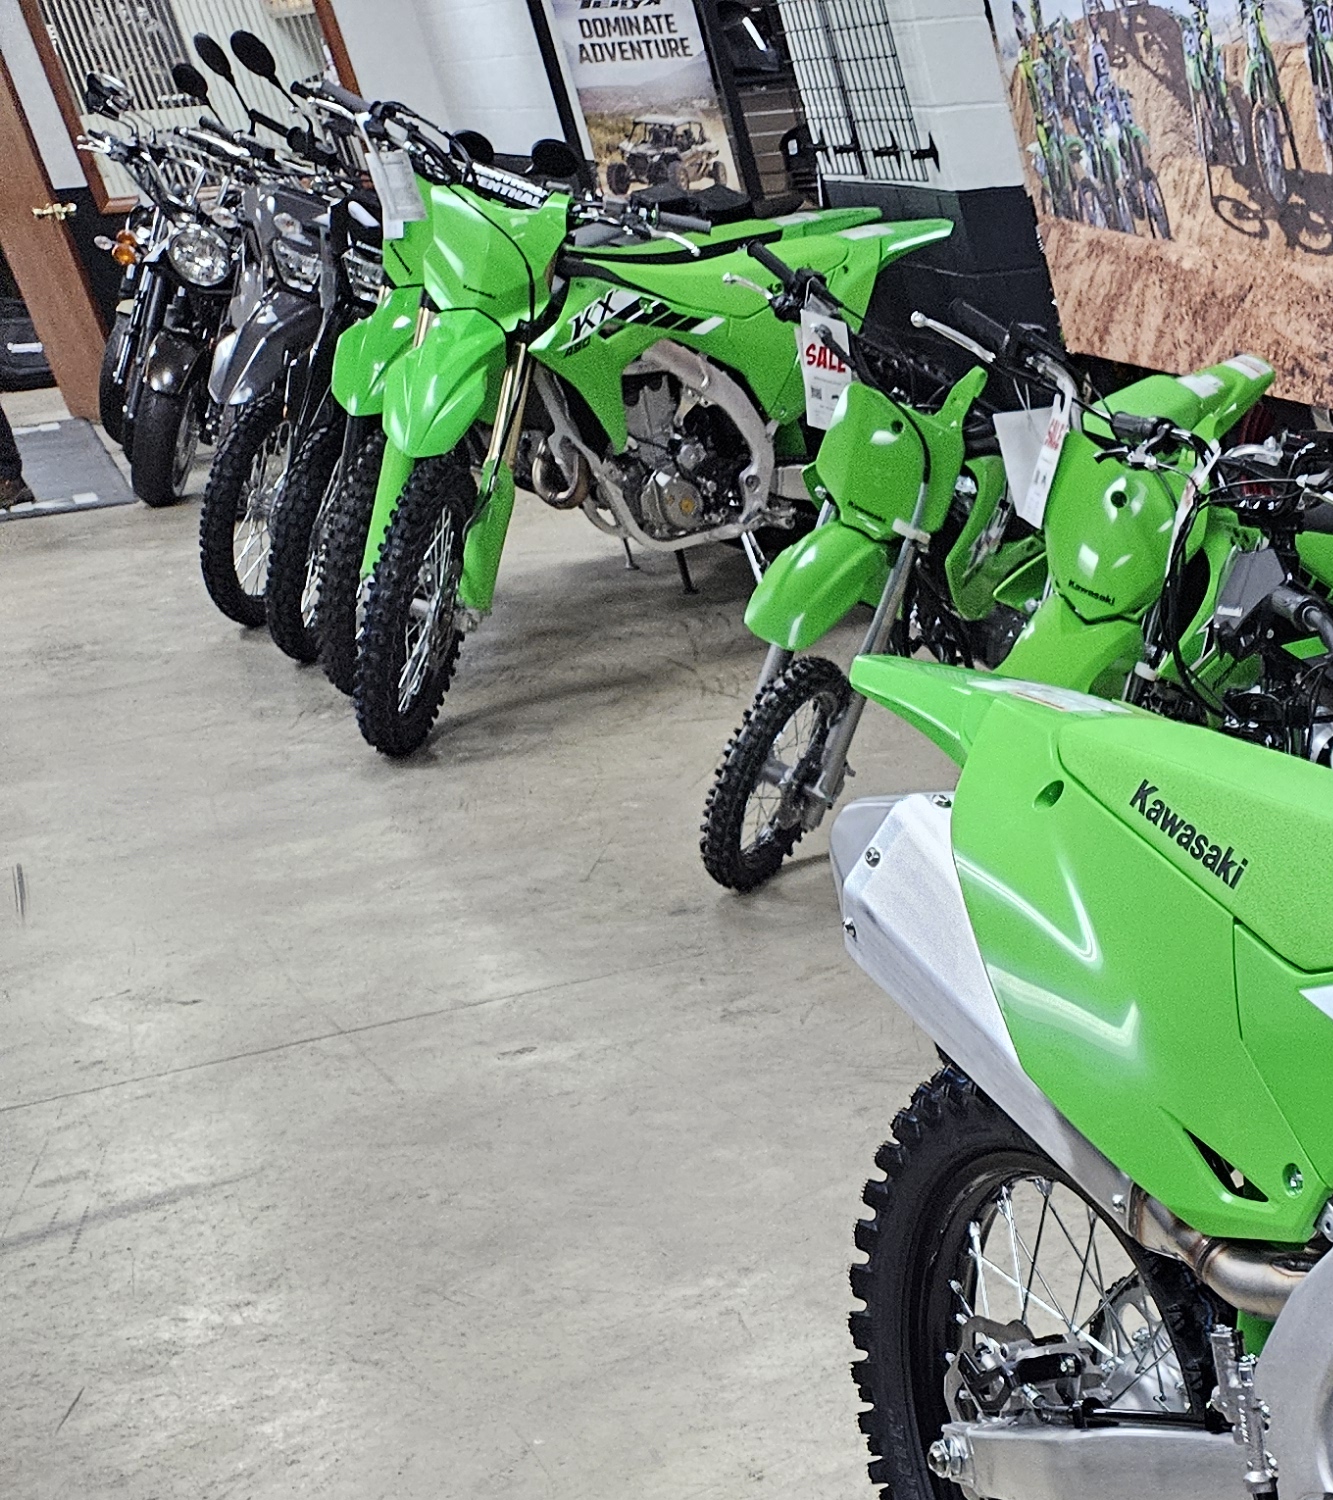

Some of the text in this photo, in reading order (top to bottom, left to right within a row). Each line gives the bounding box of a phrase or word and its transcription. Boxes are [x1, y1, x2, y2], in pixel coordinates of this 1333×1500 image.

[578, 13, 678, 39] DOMINATE
[578, 37, 693, 64] ADVENTURE
[567, 287, 619, 342] KX
[1129, 778, 1249, 890] Kawasaki
